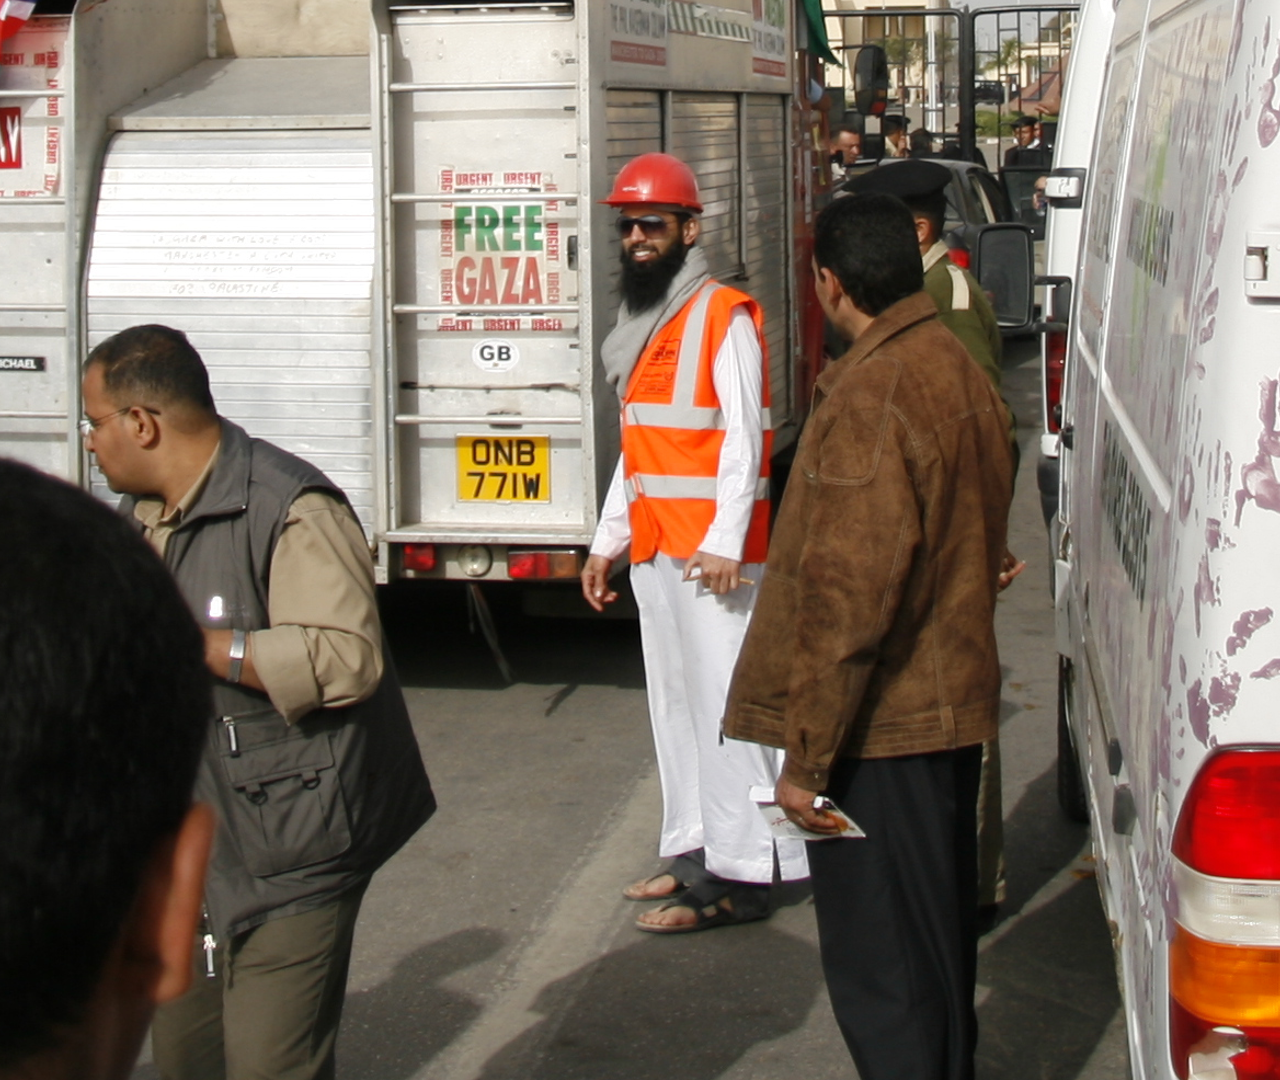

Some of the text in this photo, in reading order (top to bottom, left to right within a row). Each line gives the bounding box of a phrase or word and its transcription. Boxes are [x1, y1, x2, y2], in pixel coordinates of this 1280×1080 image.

[456, 172, 542, 186] URGENT URGENT
[454, 205, 543, 251] FREE
[455, 256, 543, 305] GAZA
[479, 345, 511, 361] GB
[472, 439, 535, 466] ONB
[467, 472, 541, 499] 771W
